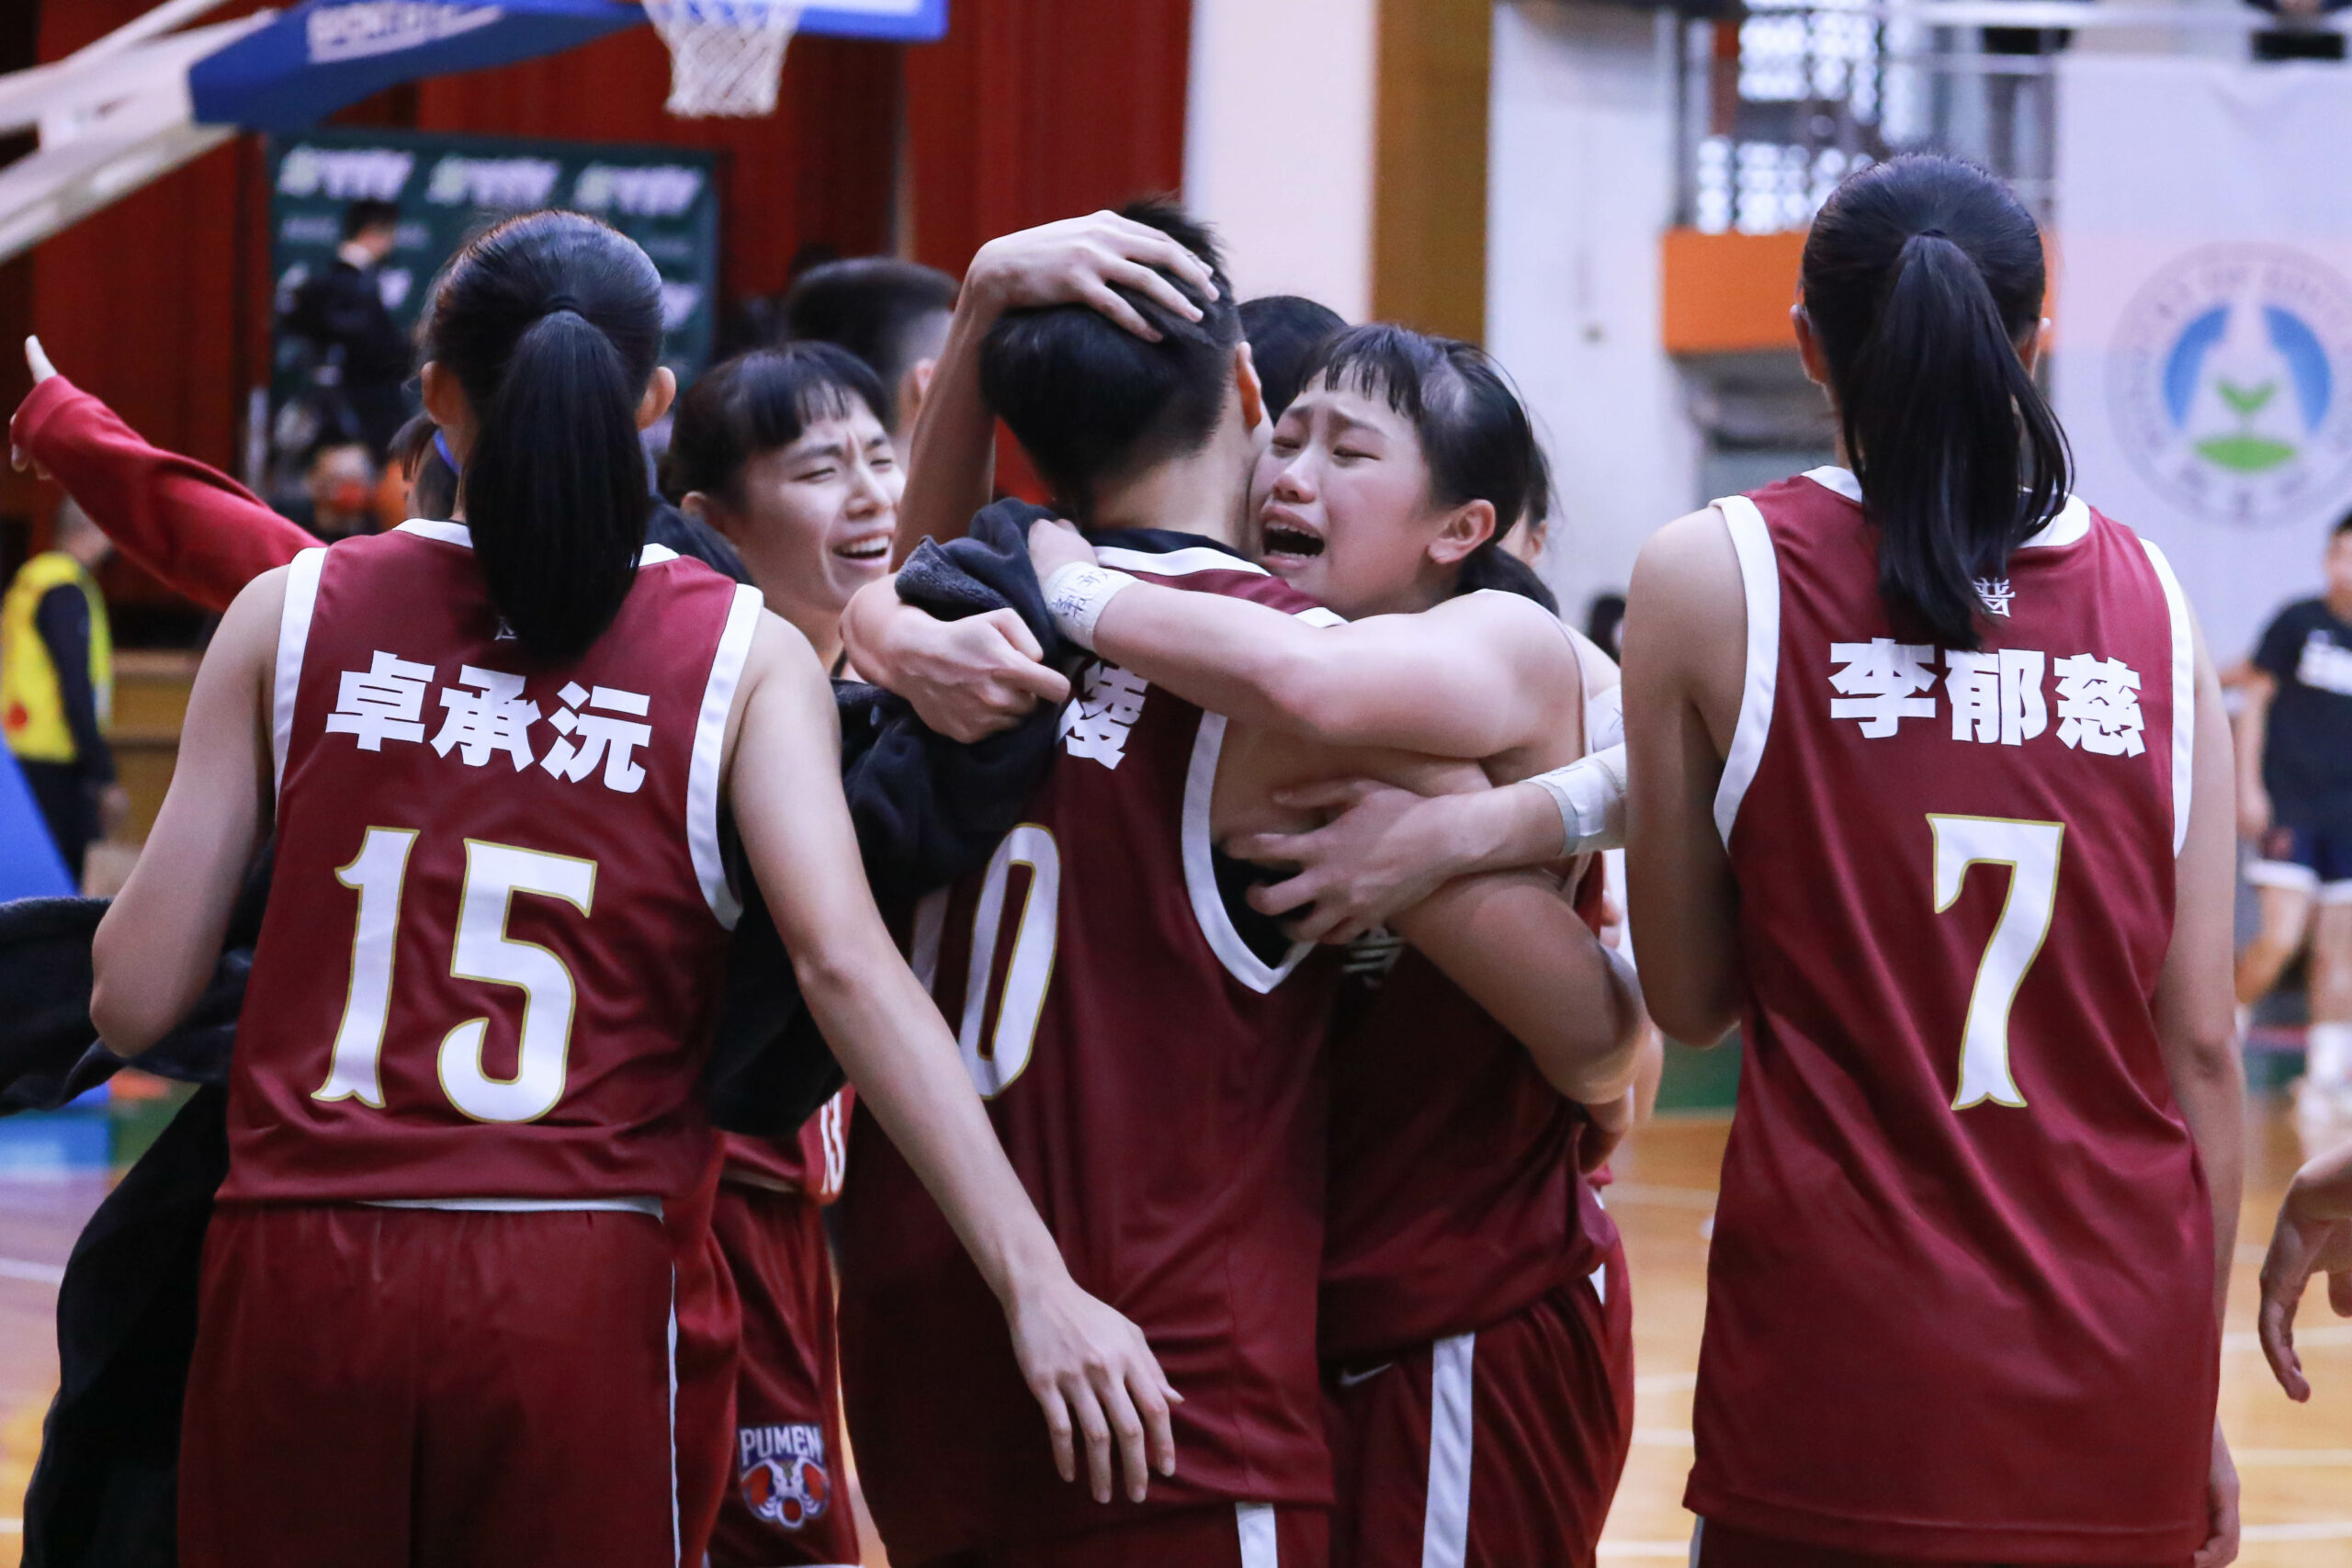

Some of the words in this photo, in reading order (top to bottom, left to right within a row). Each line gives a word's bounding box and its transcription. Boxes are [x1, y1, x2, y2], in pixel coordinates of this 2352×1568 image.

[326, 650, 651, 794] 卓承沅
[1829, 637, 2147, 758] 李郁慈
[311, 826, 598, 1123] 15
[1926, 813, 2065, 1111] 7
[740, 1426, 824, 1467] PUMEN
